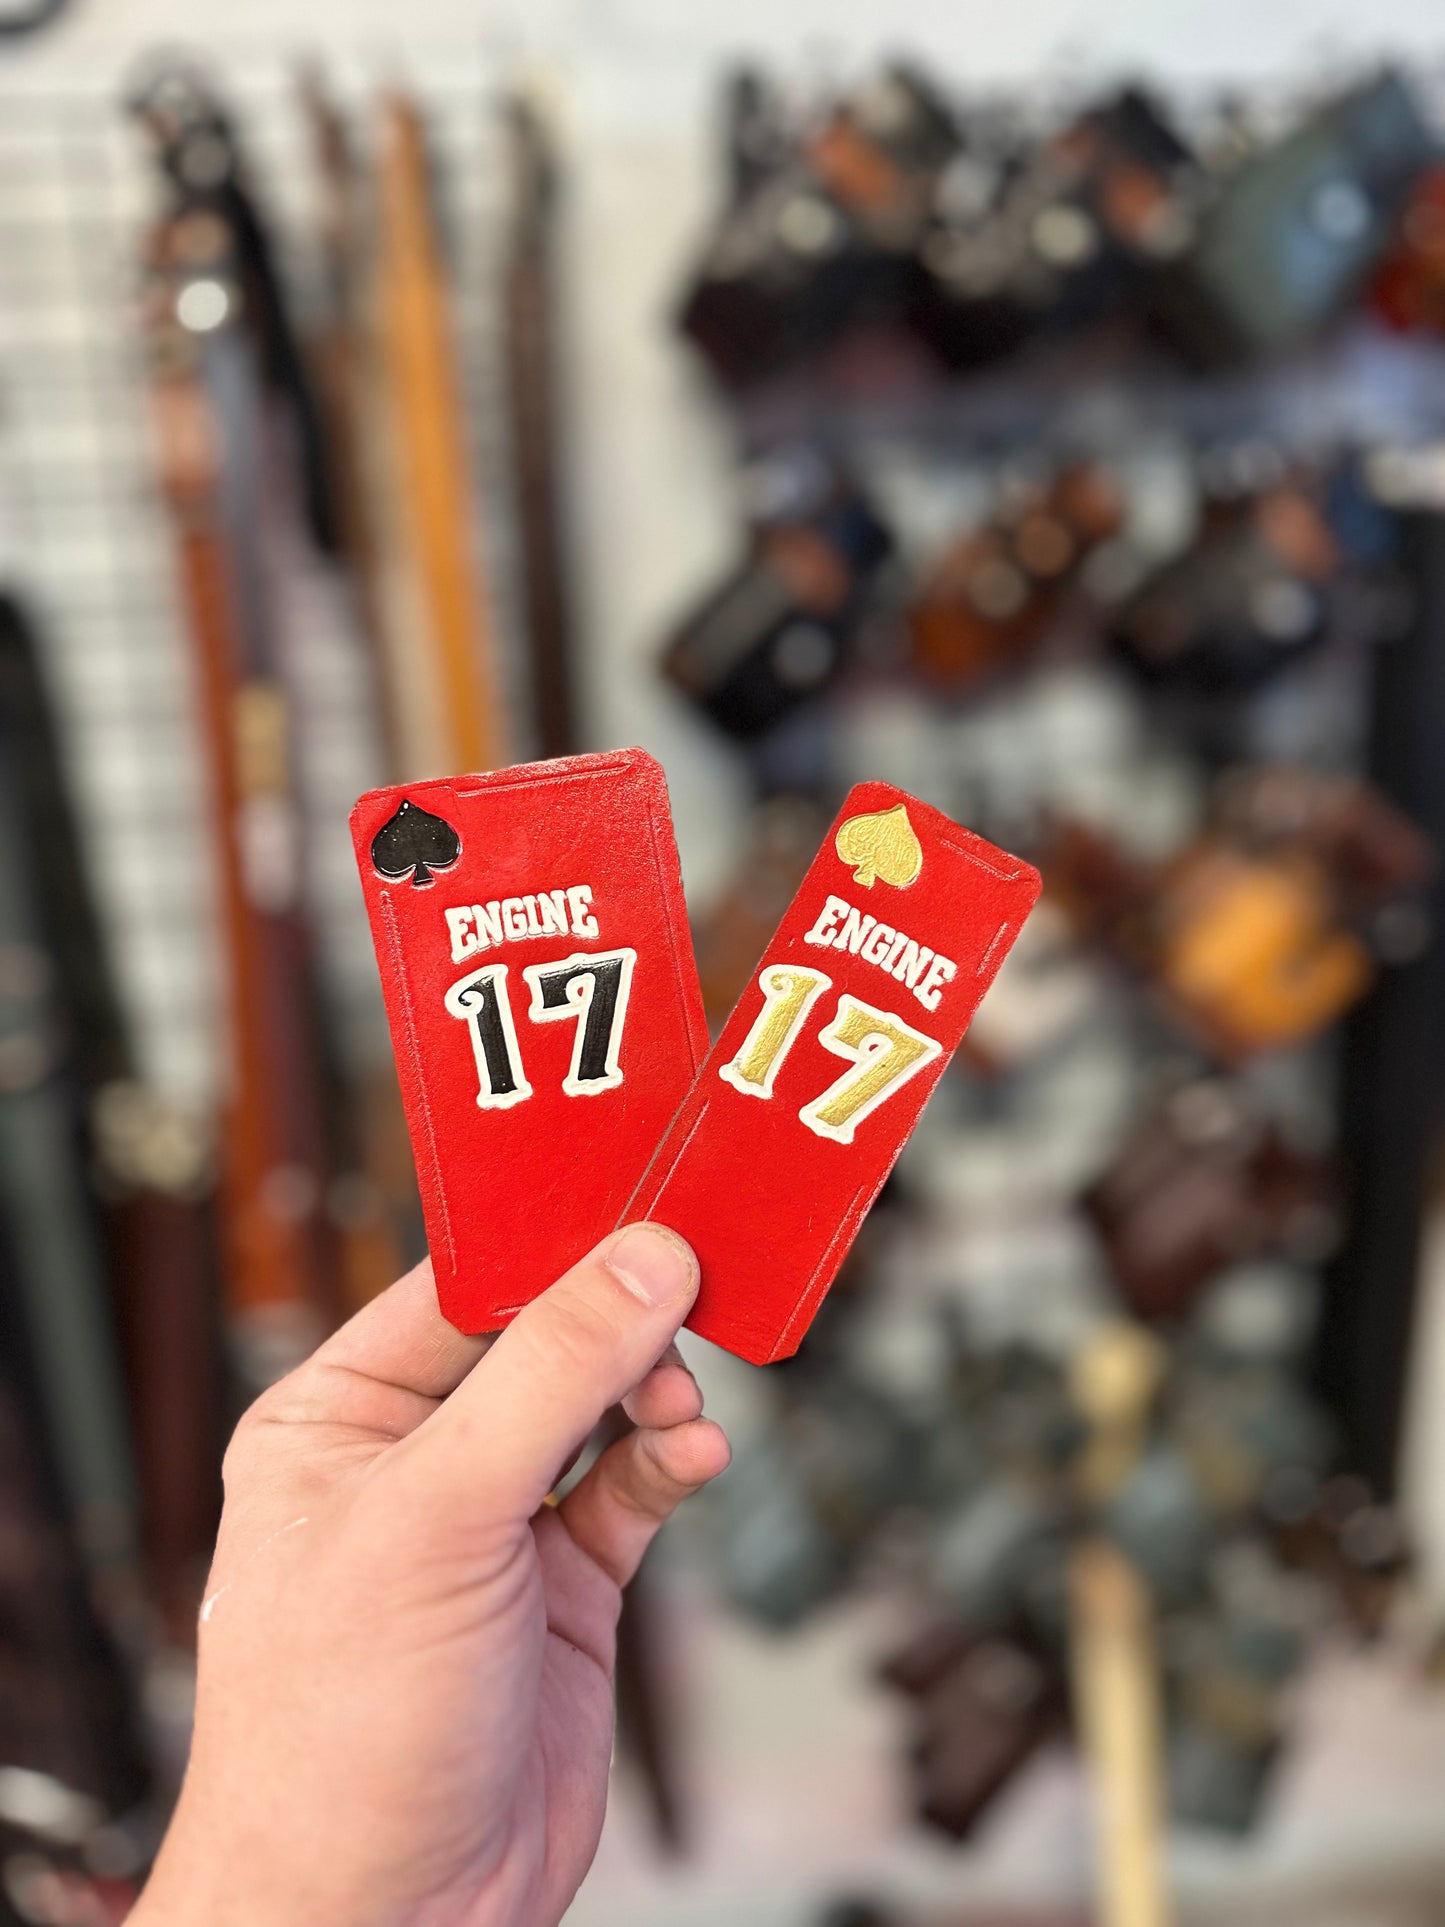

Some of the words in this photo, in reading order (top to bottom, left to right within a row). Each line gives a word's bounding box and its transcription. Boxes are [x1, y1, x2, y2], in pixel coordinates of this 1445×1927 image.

[444, 884, 600, 964] ENGINE
[804, 894, 958, 1012] ENGINE
[444, 947, 637, 1109] 17
[718, 963, 943, 1145] 17
